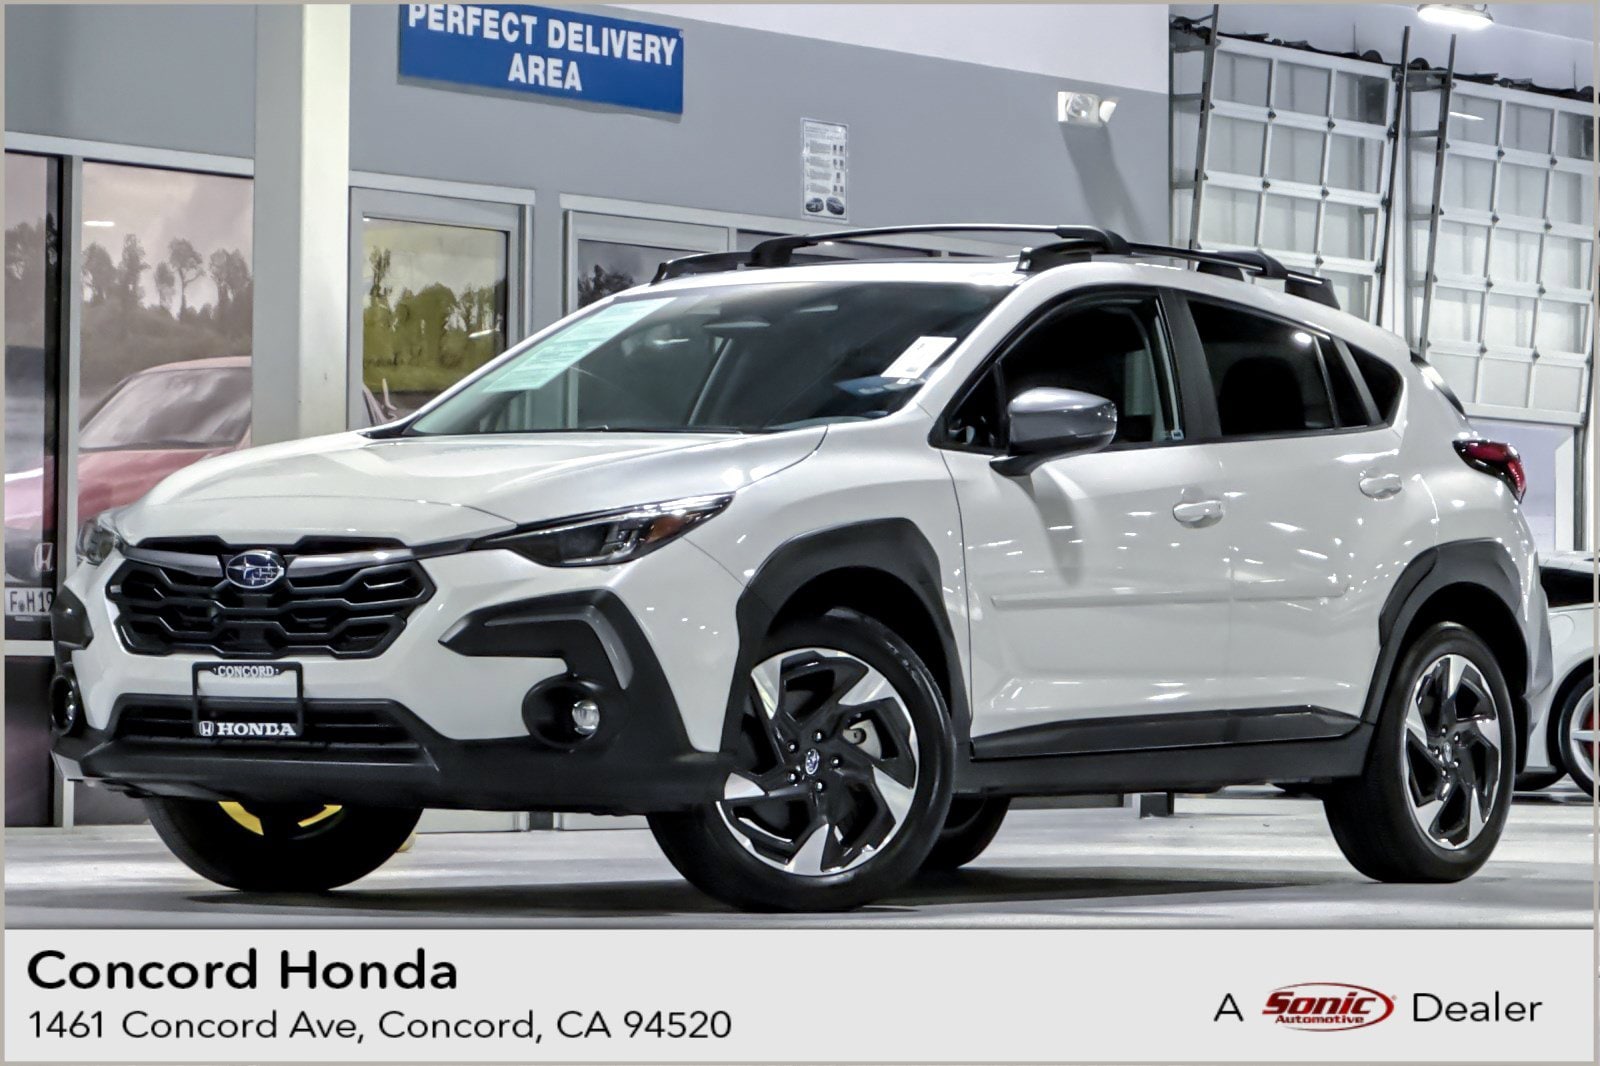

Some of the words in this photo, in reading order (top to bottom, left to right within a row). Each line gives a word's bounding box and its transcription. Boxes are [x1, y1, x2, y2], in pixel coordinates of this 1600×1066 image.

[408, 4, 538, 45] PERFECT
[547, 19, 678, 66] DELIVERY
[507, 53, 583, 91] AREA
[217, 665, 275, 677] CONCORD
[216, 722, 296, 736] HONDA
